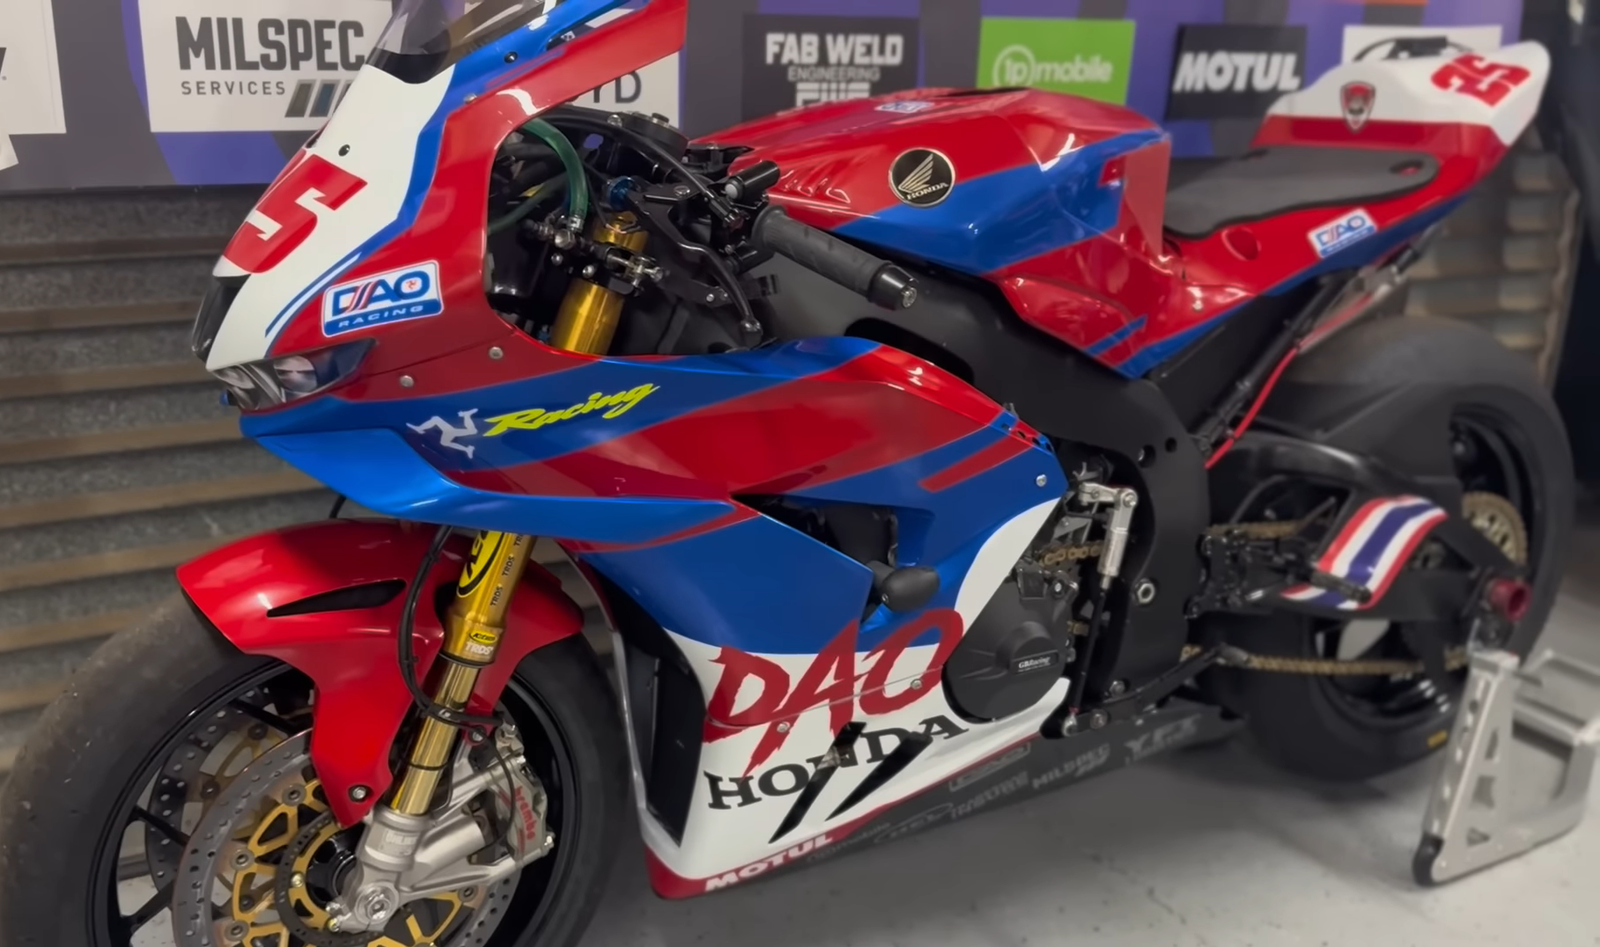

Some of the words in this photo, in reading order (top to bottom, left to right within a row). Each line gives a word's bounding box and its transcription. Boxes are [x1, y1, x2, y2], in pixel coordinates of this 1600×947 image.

[175, 16, 365, 71] MILSPEC
[766, 33, 819, 65] FAB
[825, 34, 904, 66] WELD
[181, 81, 286, 95] SERVICES
[787, 66, 881, 82] ENGINEERING
[1172, 50, 1300, 92] MOTUL
[906, 182, 949, 200] HONDA
[332, 270, 431, 317] DAO
[338, 304, 424, 328] RACING
[483, 383, 661, 437] Racing
[702, 608, 964, 785] DAO
[514, 785, 537, 841] brembo
[705, 833, 833, 893] MOTUL
